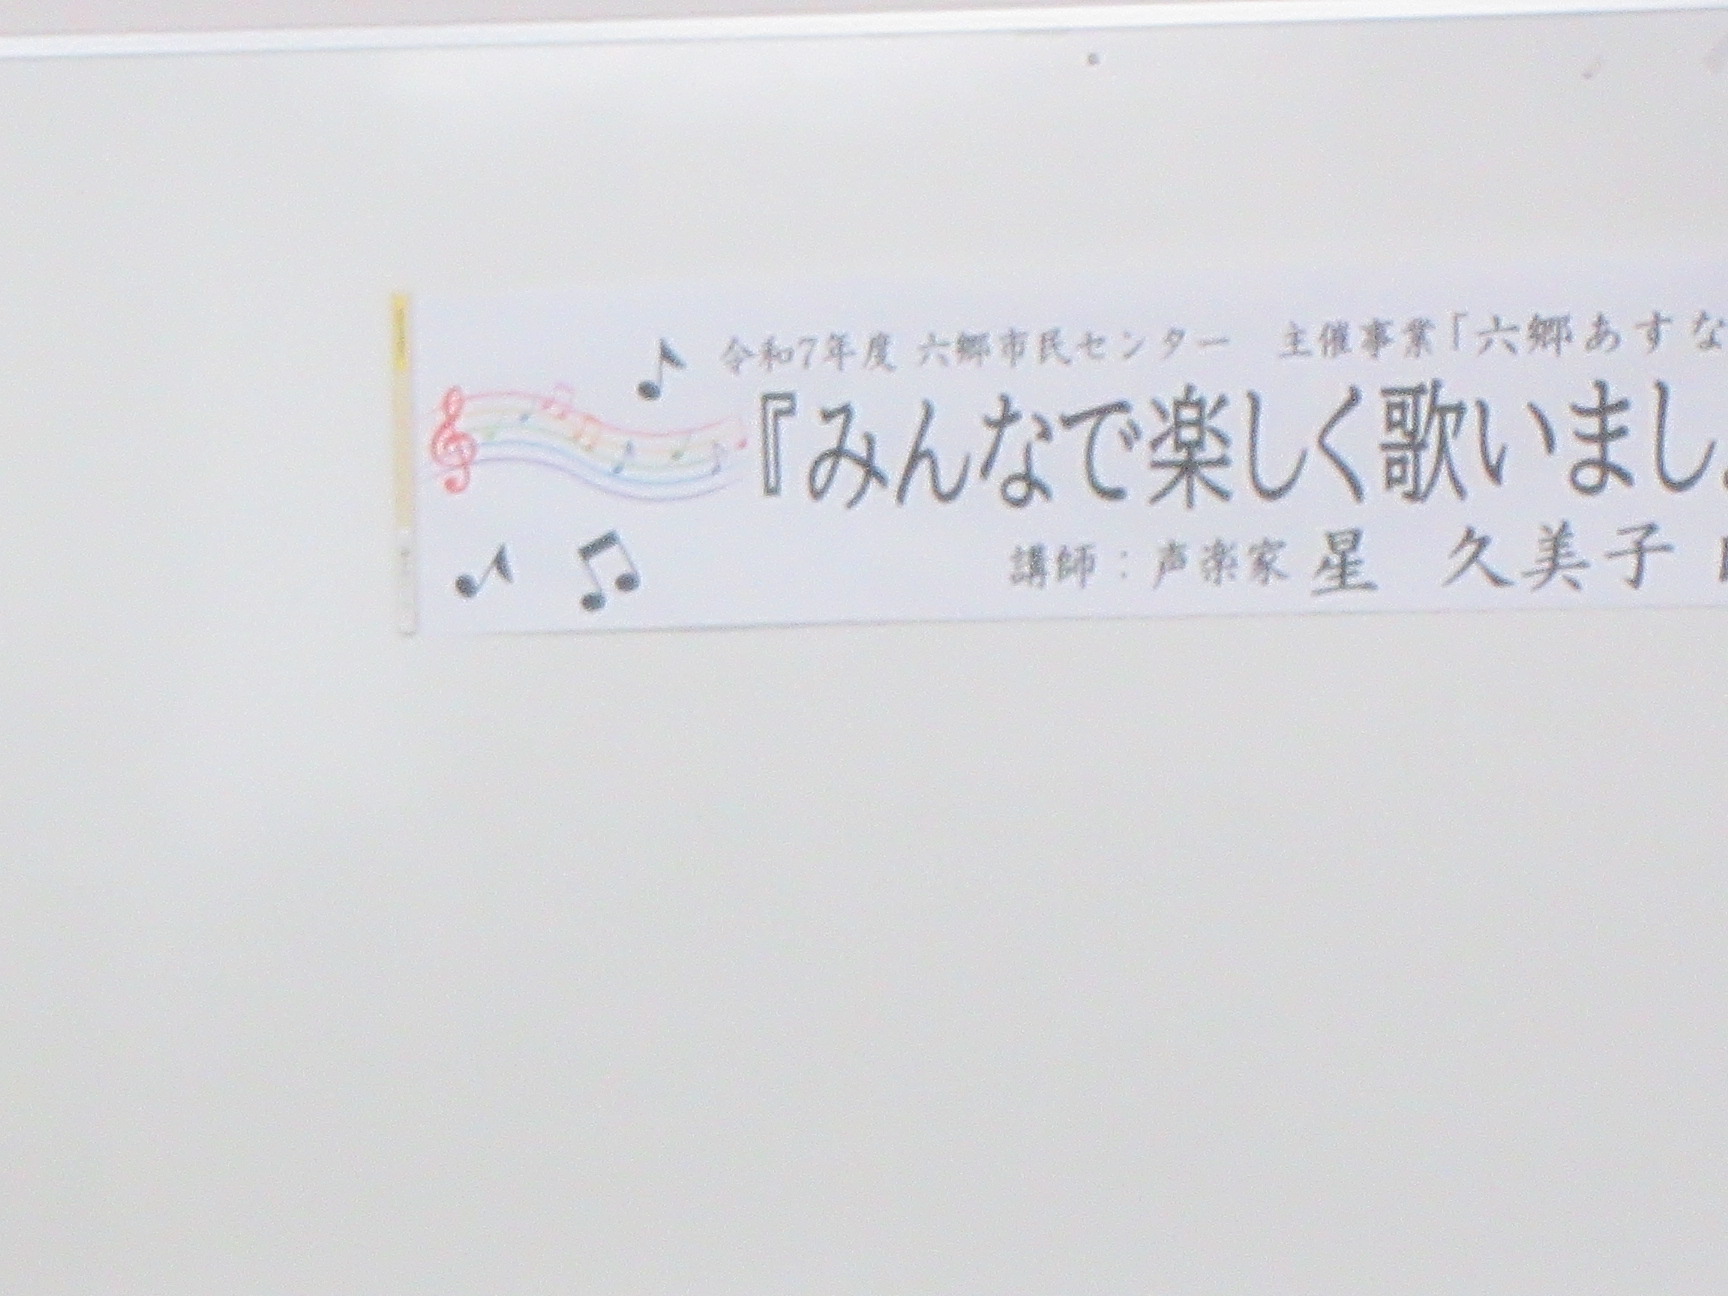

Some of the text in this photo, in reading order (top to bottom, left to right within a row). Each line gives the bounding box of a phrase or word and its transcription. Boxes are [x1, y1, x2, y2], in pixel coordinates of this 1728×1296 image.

[721, 330, 897, 374] 令和7年度
[917, 326, 1230, 369] 六郷市民センター
[760, 378, 1728, 508] 『みんなで楽しく歌いまし
[1446, 519, 1675, 593] 久美子
